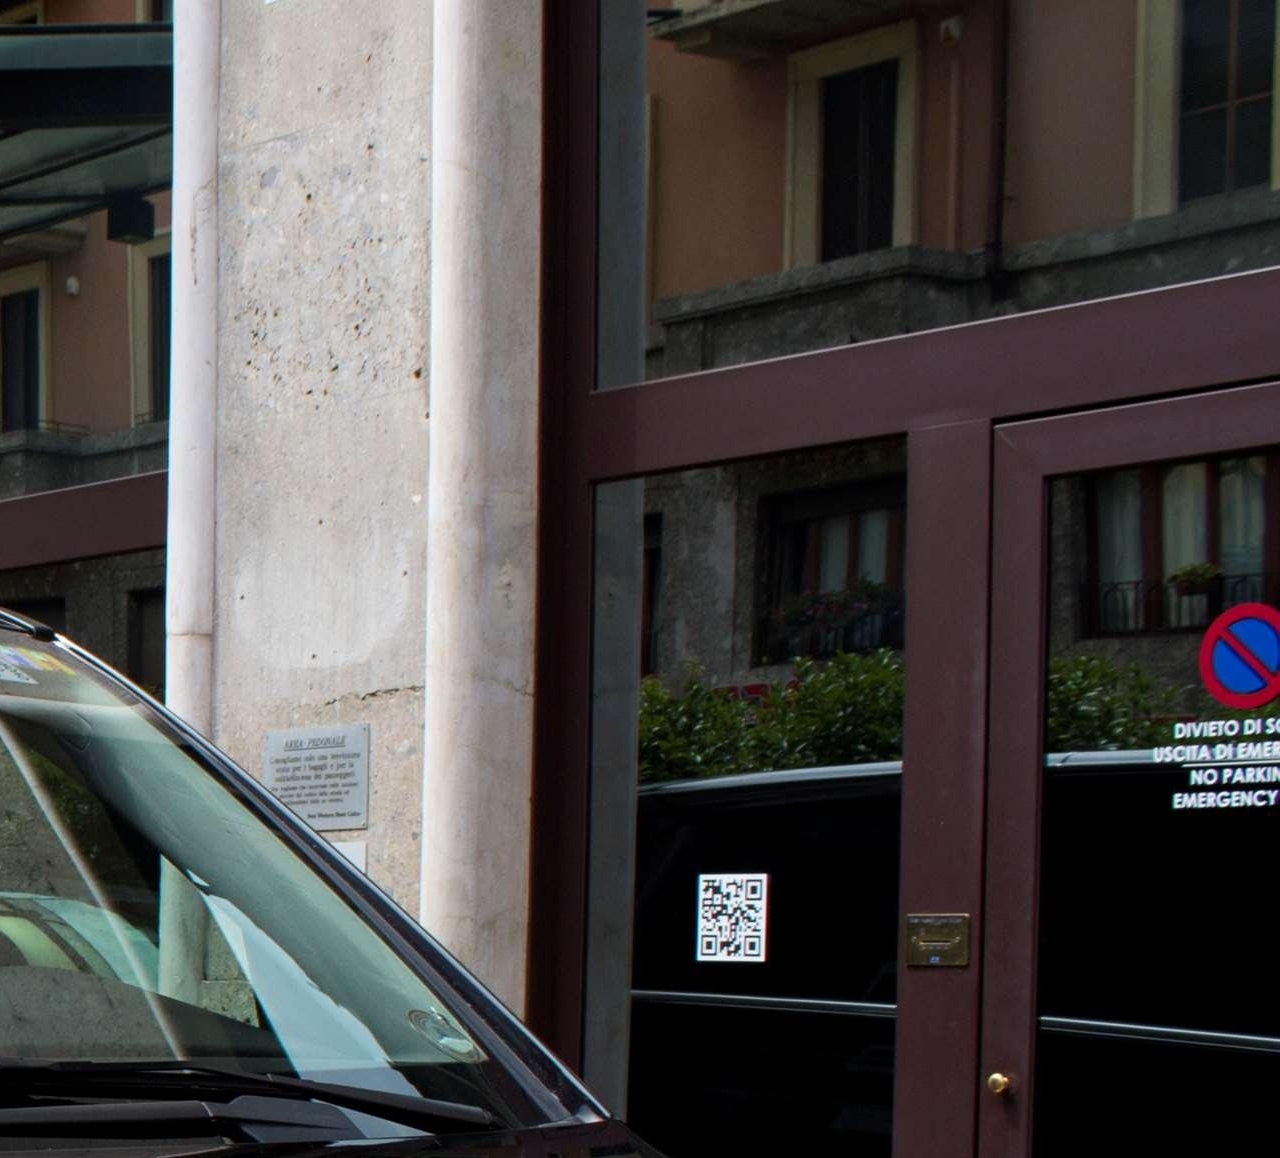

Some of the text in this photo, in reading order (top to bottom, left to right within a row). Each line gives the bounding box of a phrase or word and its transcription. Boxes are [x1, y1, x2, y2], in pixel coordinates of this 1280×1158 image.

[1174, 720, 1240, 738] DIVIETO
[1244, 719, 1262, 735] DI
[1152, 745, 1211, 762] USCITA
[1215, 743, 1234, 759] DI
[1190, 769, 1218, 785] NO
[1172, 790, 1279, 809] EMERGENCY
